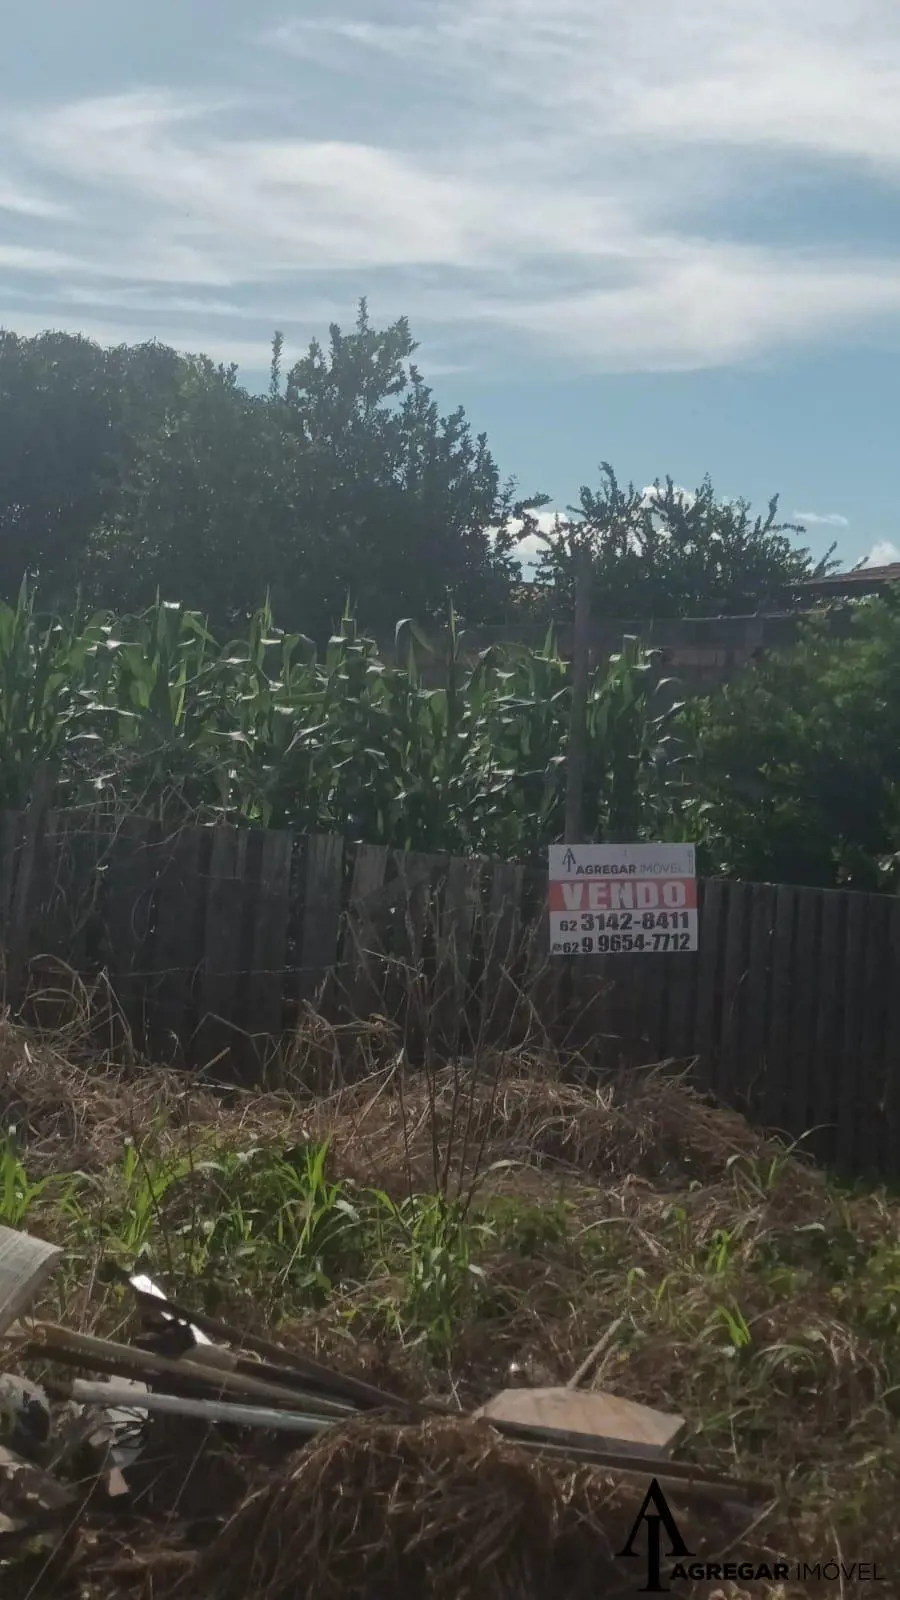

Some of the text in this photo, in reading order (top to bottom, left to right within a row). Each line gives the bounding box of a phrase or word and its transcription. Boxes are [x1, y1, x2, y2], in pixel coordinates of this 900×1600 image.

[576, 865, 636, 875] AGREGAR
[562, 882, 686, 910] VENDO
[560, 912, 689, 931] 62 3142-8411
[563, 934, 690, 953] 62 9 9654-7712
